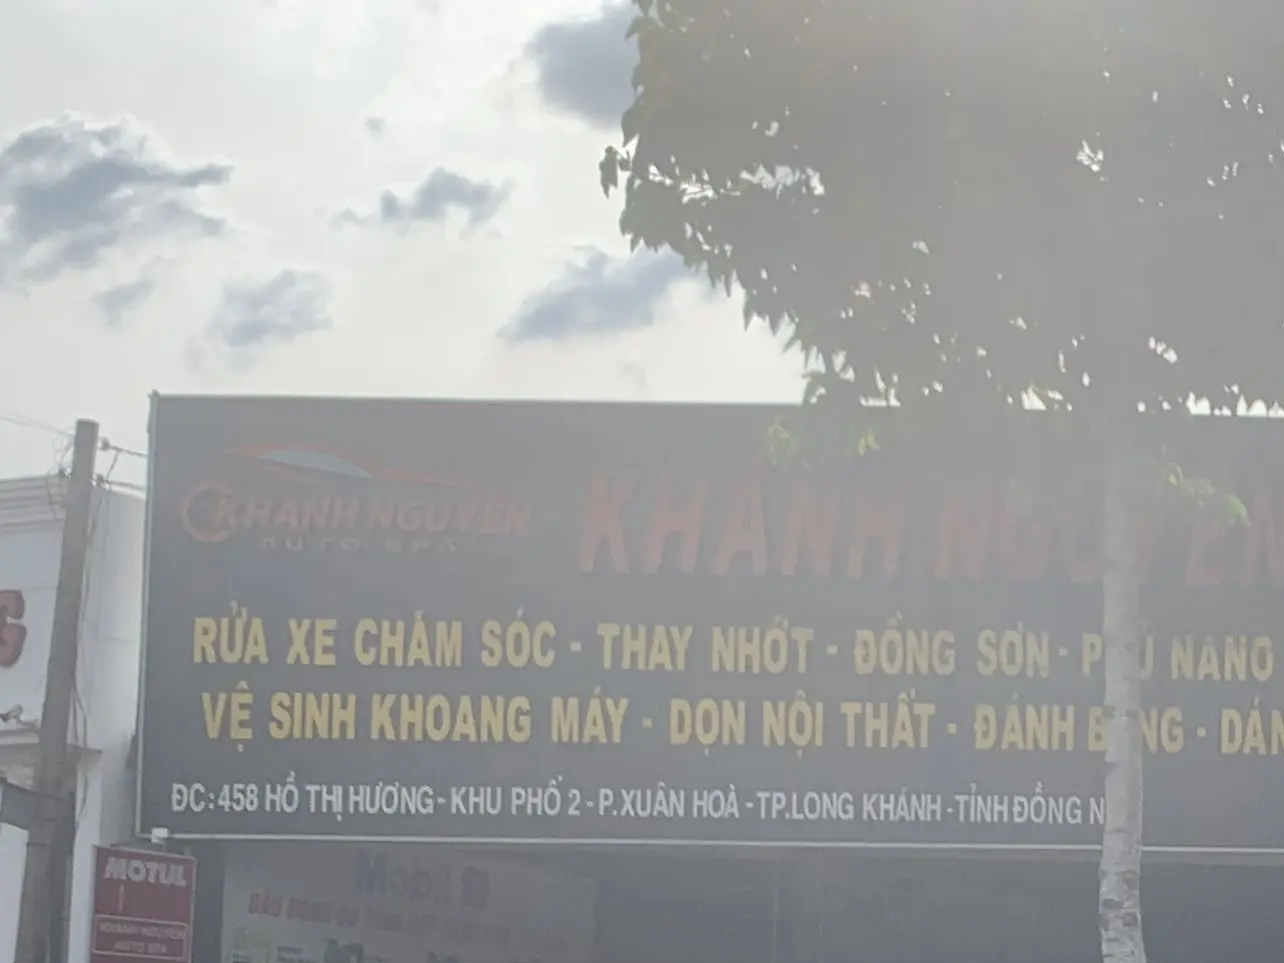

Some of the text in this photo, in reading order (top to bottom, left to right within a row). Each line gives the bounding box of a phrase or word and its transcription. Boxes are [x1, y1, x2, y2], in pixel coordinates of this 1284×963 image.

[193, 600, 269, 664] RỬA
[286, 618, 337, 666] XE
[354, 610, 463, 668] CHĂM
[481, 607, 557, 668] SÓC
[597, 622, 694, 671] THAY
[711, 615, 815, 674] NHỚT
[854, 612, 957, 675] ĐỒNG
[1082, 618, 1155, 680] PỦ
[1170, 634, 1275, 683] NANO
[201, 680, 254, 752] VỆ
[268, 691, 356, 740] SINH
[370, 693, 532, 744] KHOANG
[551, 685, 630, 744] MÁY
[669, 698, 746, 757] DỌN
[762, 688, 824, 759] NỘI
[839, 688, 936, 748] THẤT
[973, 693, 1075, 751] ĐÁNH
[1087, 703, 1185, 754] BNG
[305, 784, 343, 822] THỊ
[511, 775, 563, 816] PHỐ
[104, 857, 188, 887] MOTUL
